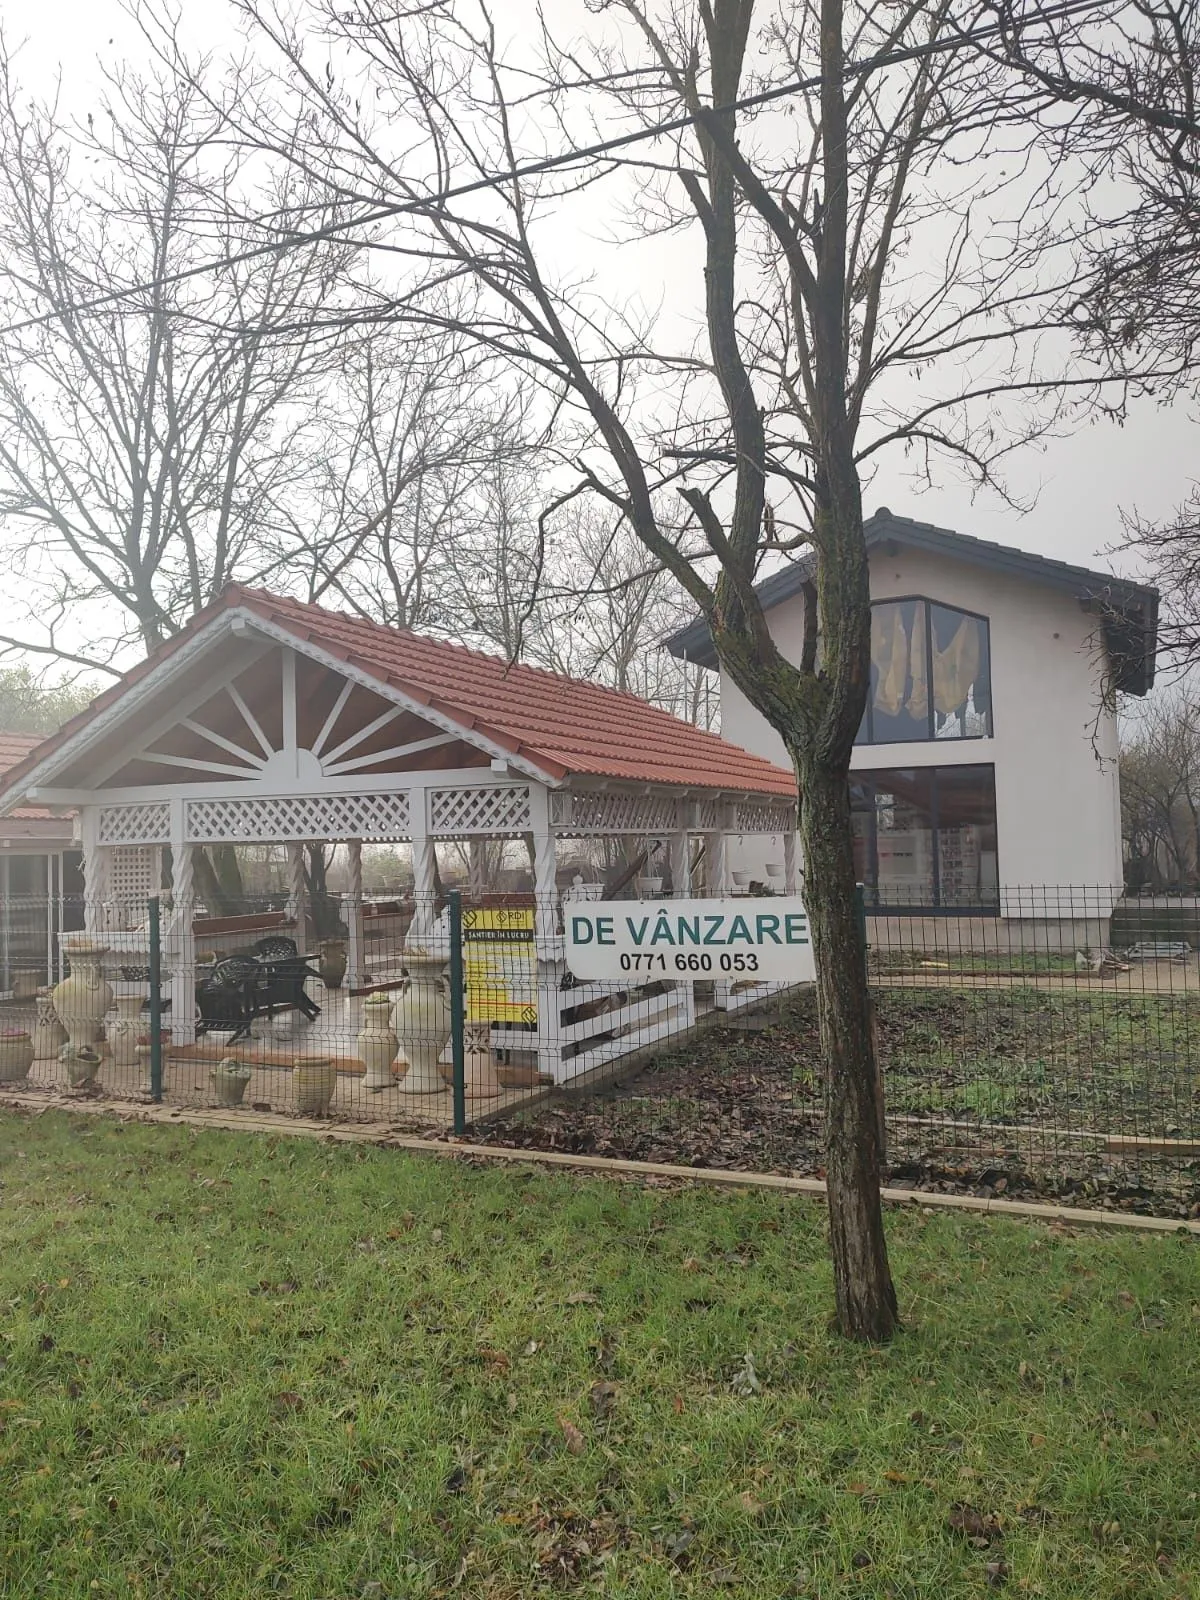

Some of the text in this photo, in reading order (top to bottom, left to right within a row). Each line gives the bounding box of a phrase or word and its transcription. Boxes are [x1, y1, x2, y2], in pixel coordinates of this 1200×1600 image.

[572, 908, 809, 946] DE VÂNZARE
[620, 953, 759, 972] 0771 660 053
